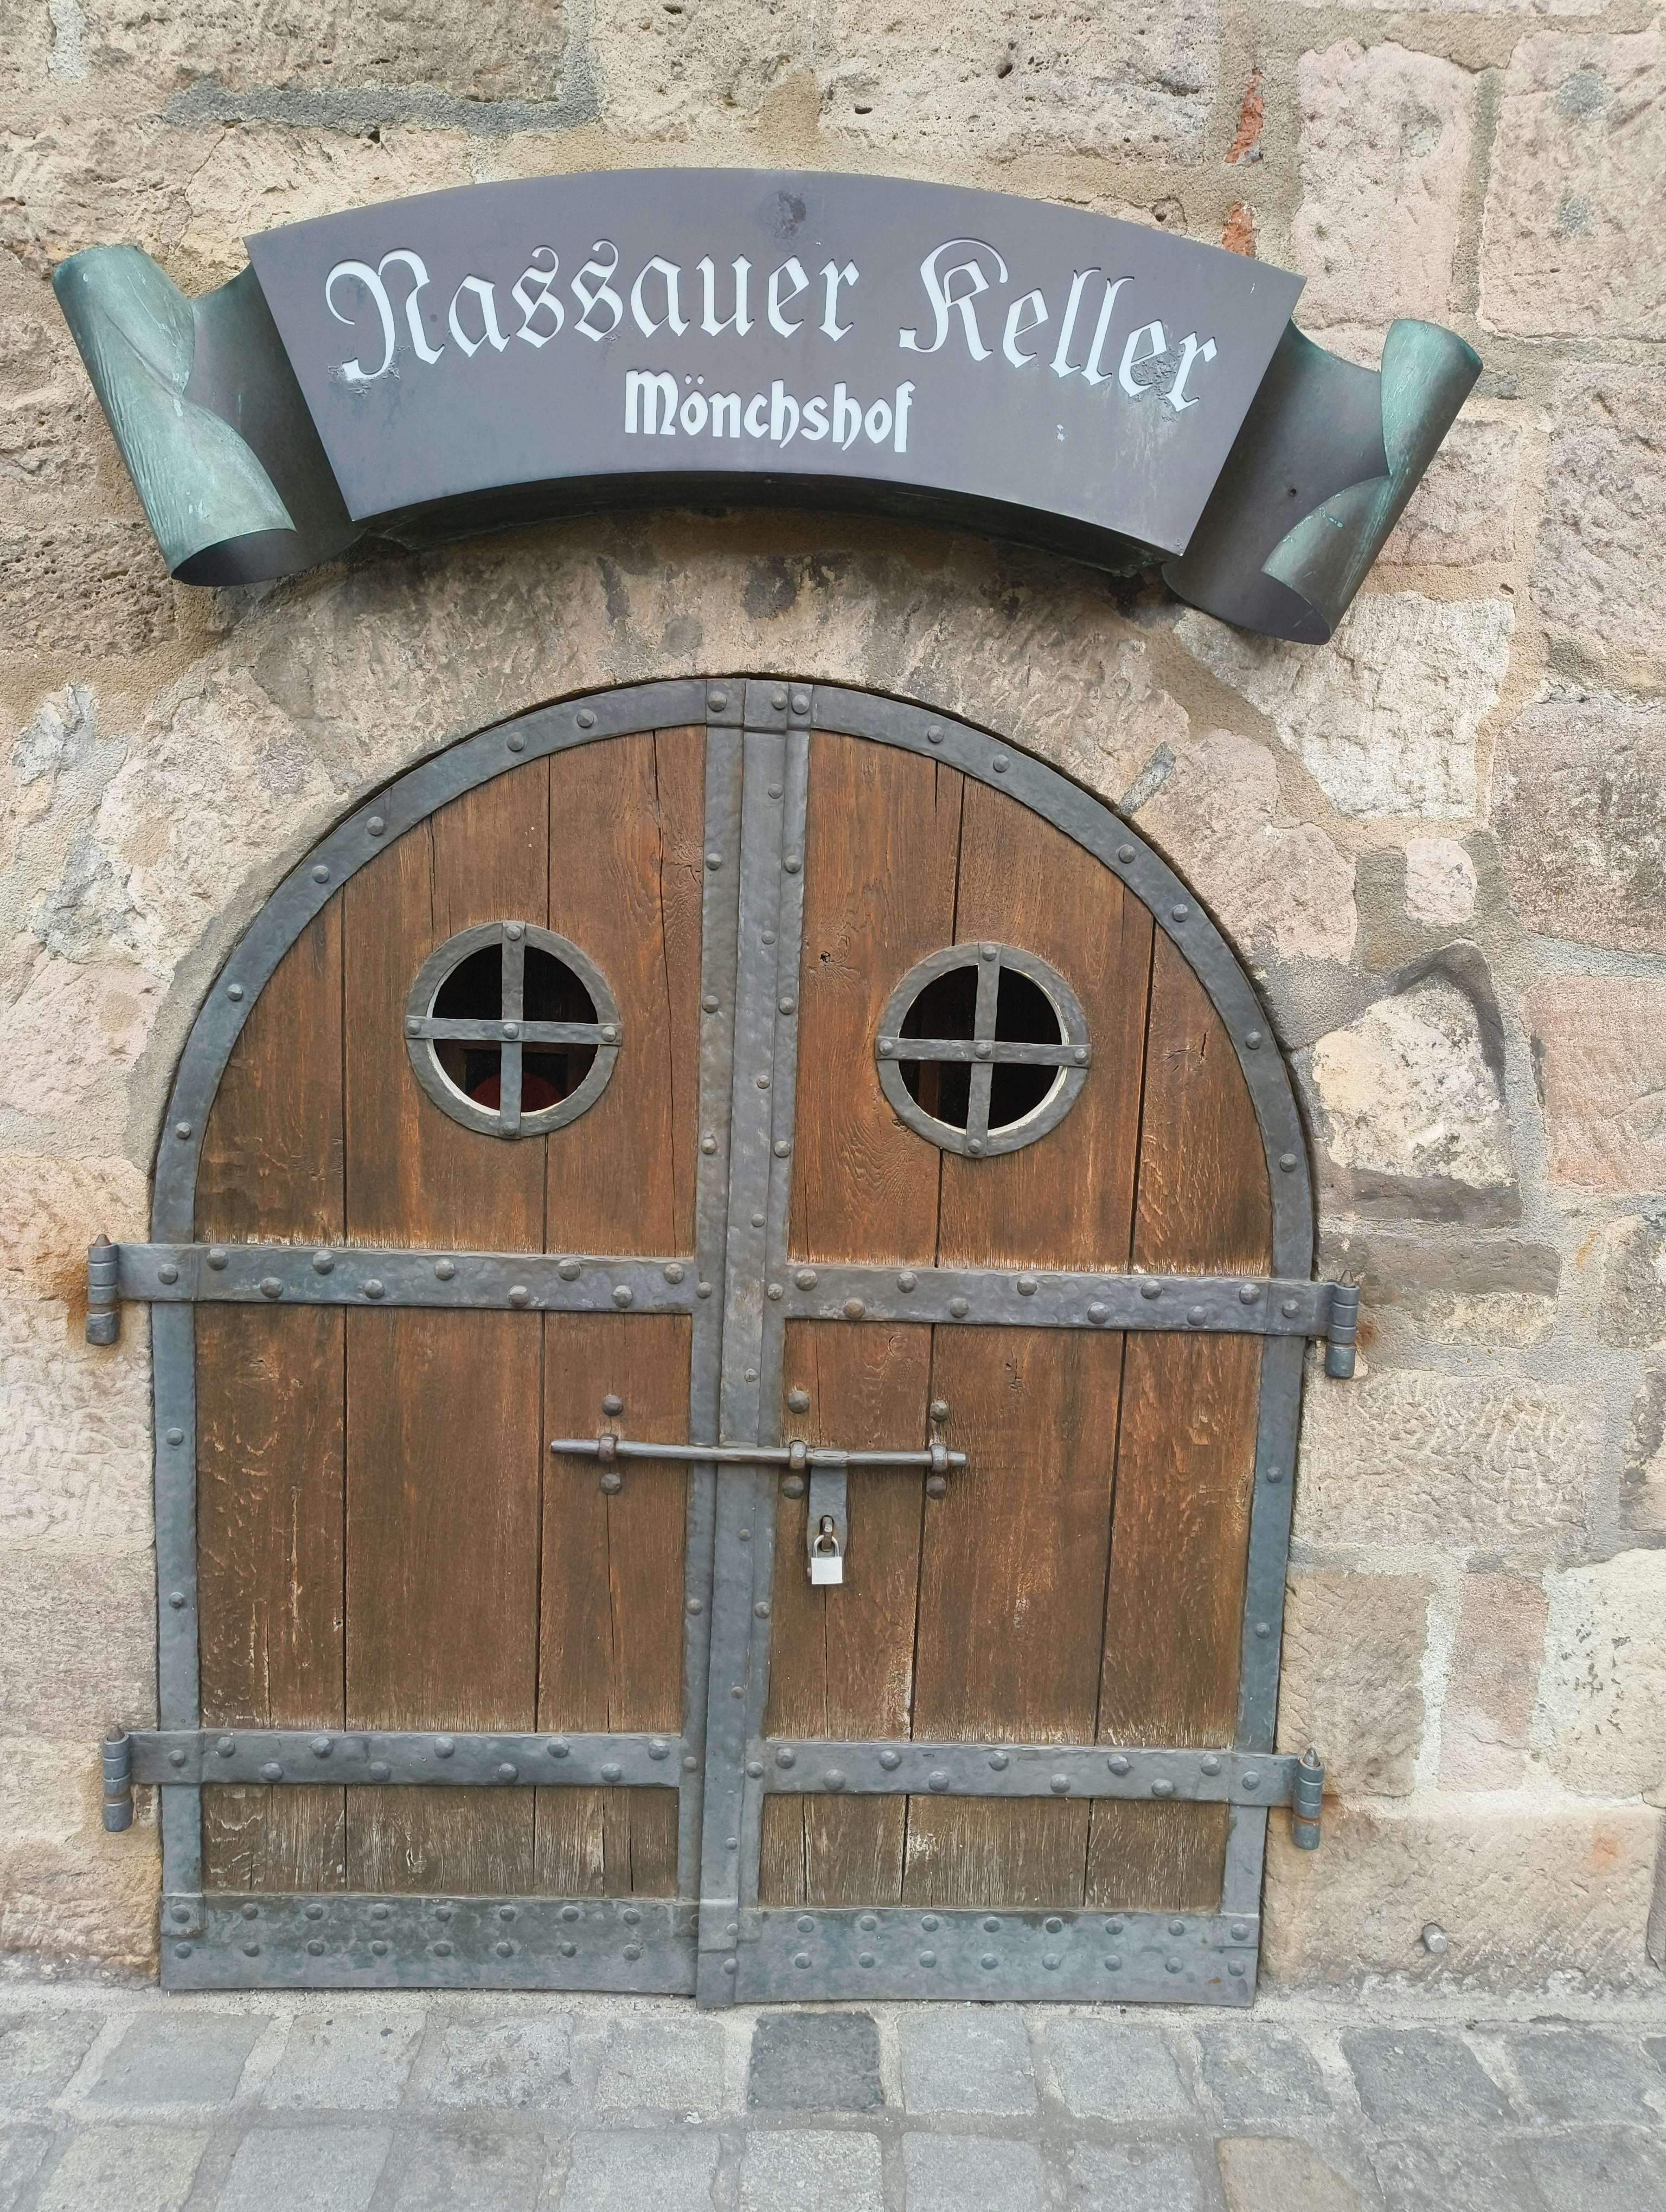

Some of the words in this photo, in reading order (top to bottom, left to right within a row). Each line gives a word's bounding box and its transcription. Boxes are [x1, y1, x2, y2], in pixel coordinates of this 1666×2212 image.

[325, 240, 860, 382] Nassauer
[899, 239, 1218, 412] Keller
[625, 370, 915, 453] Mönchshof
